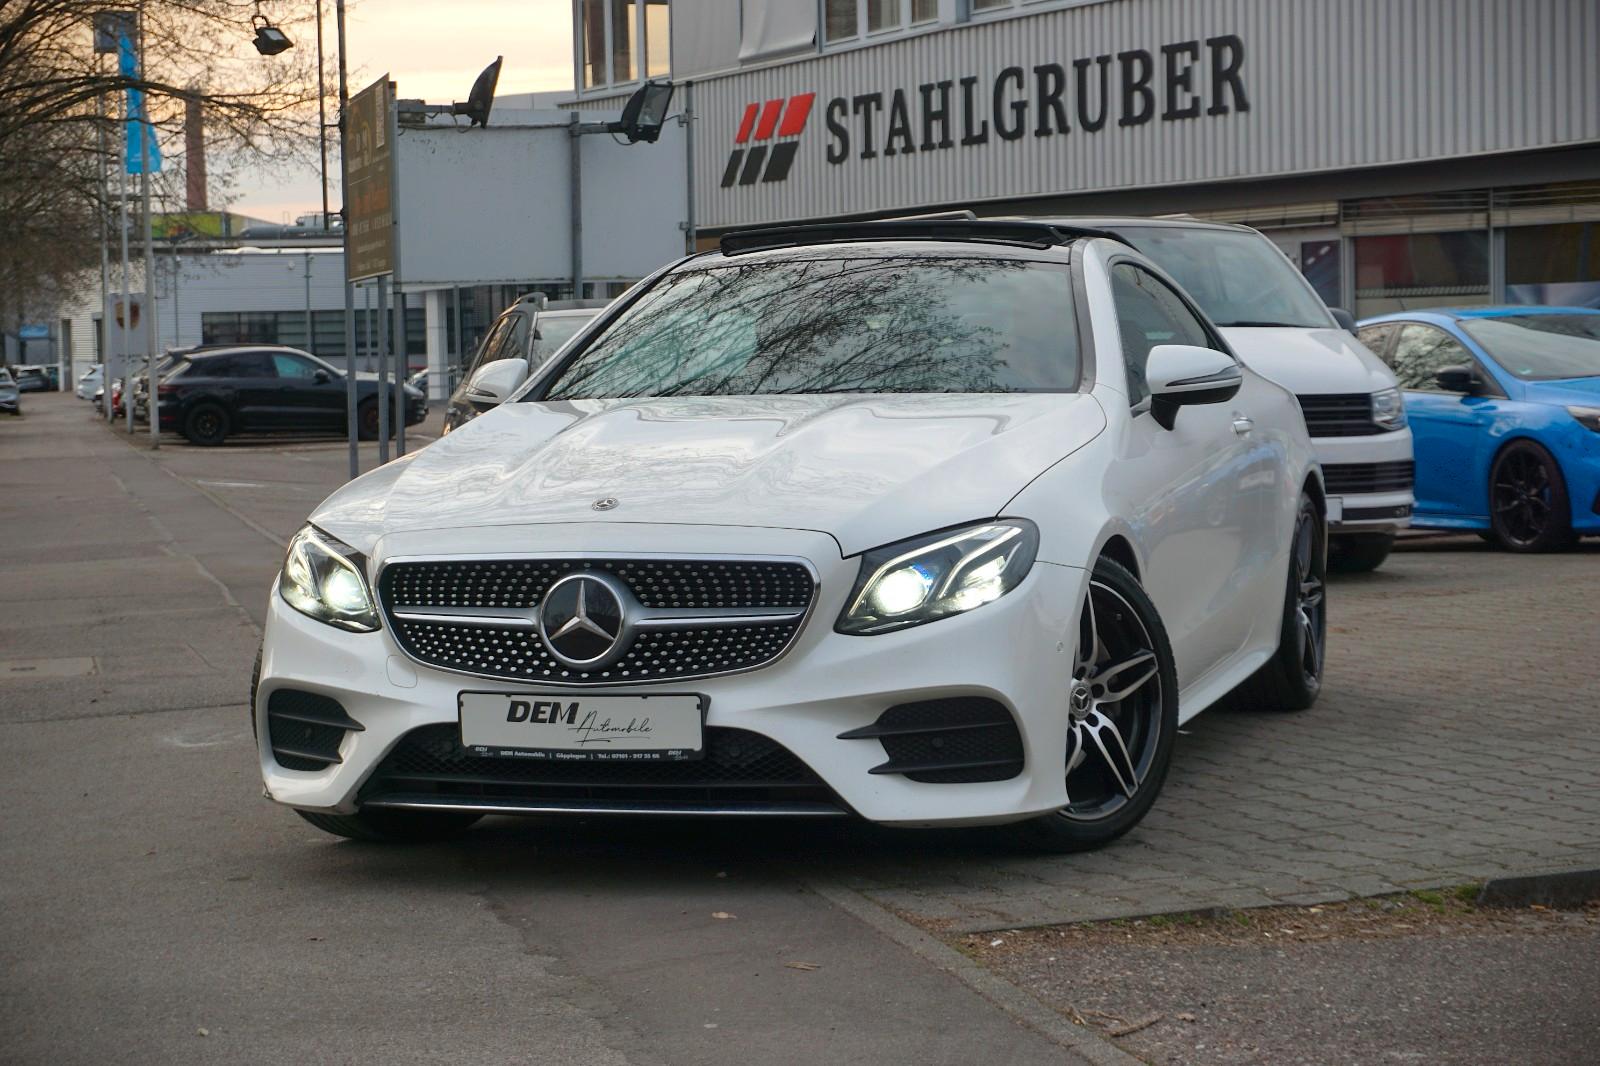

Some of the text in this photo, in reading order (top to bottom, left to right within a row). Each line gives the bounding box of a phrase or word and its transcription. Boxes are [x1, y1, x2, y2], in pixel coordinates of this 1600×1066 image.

[826, 34, 1252, 164] STAHLGRUBER
[506, 700, 580, 724] DEM
[568, 710, 653, 746] Automobile
